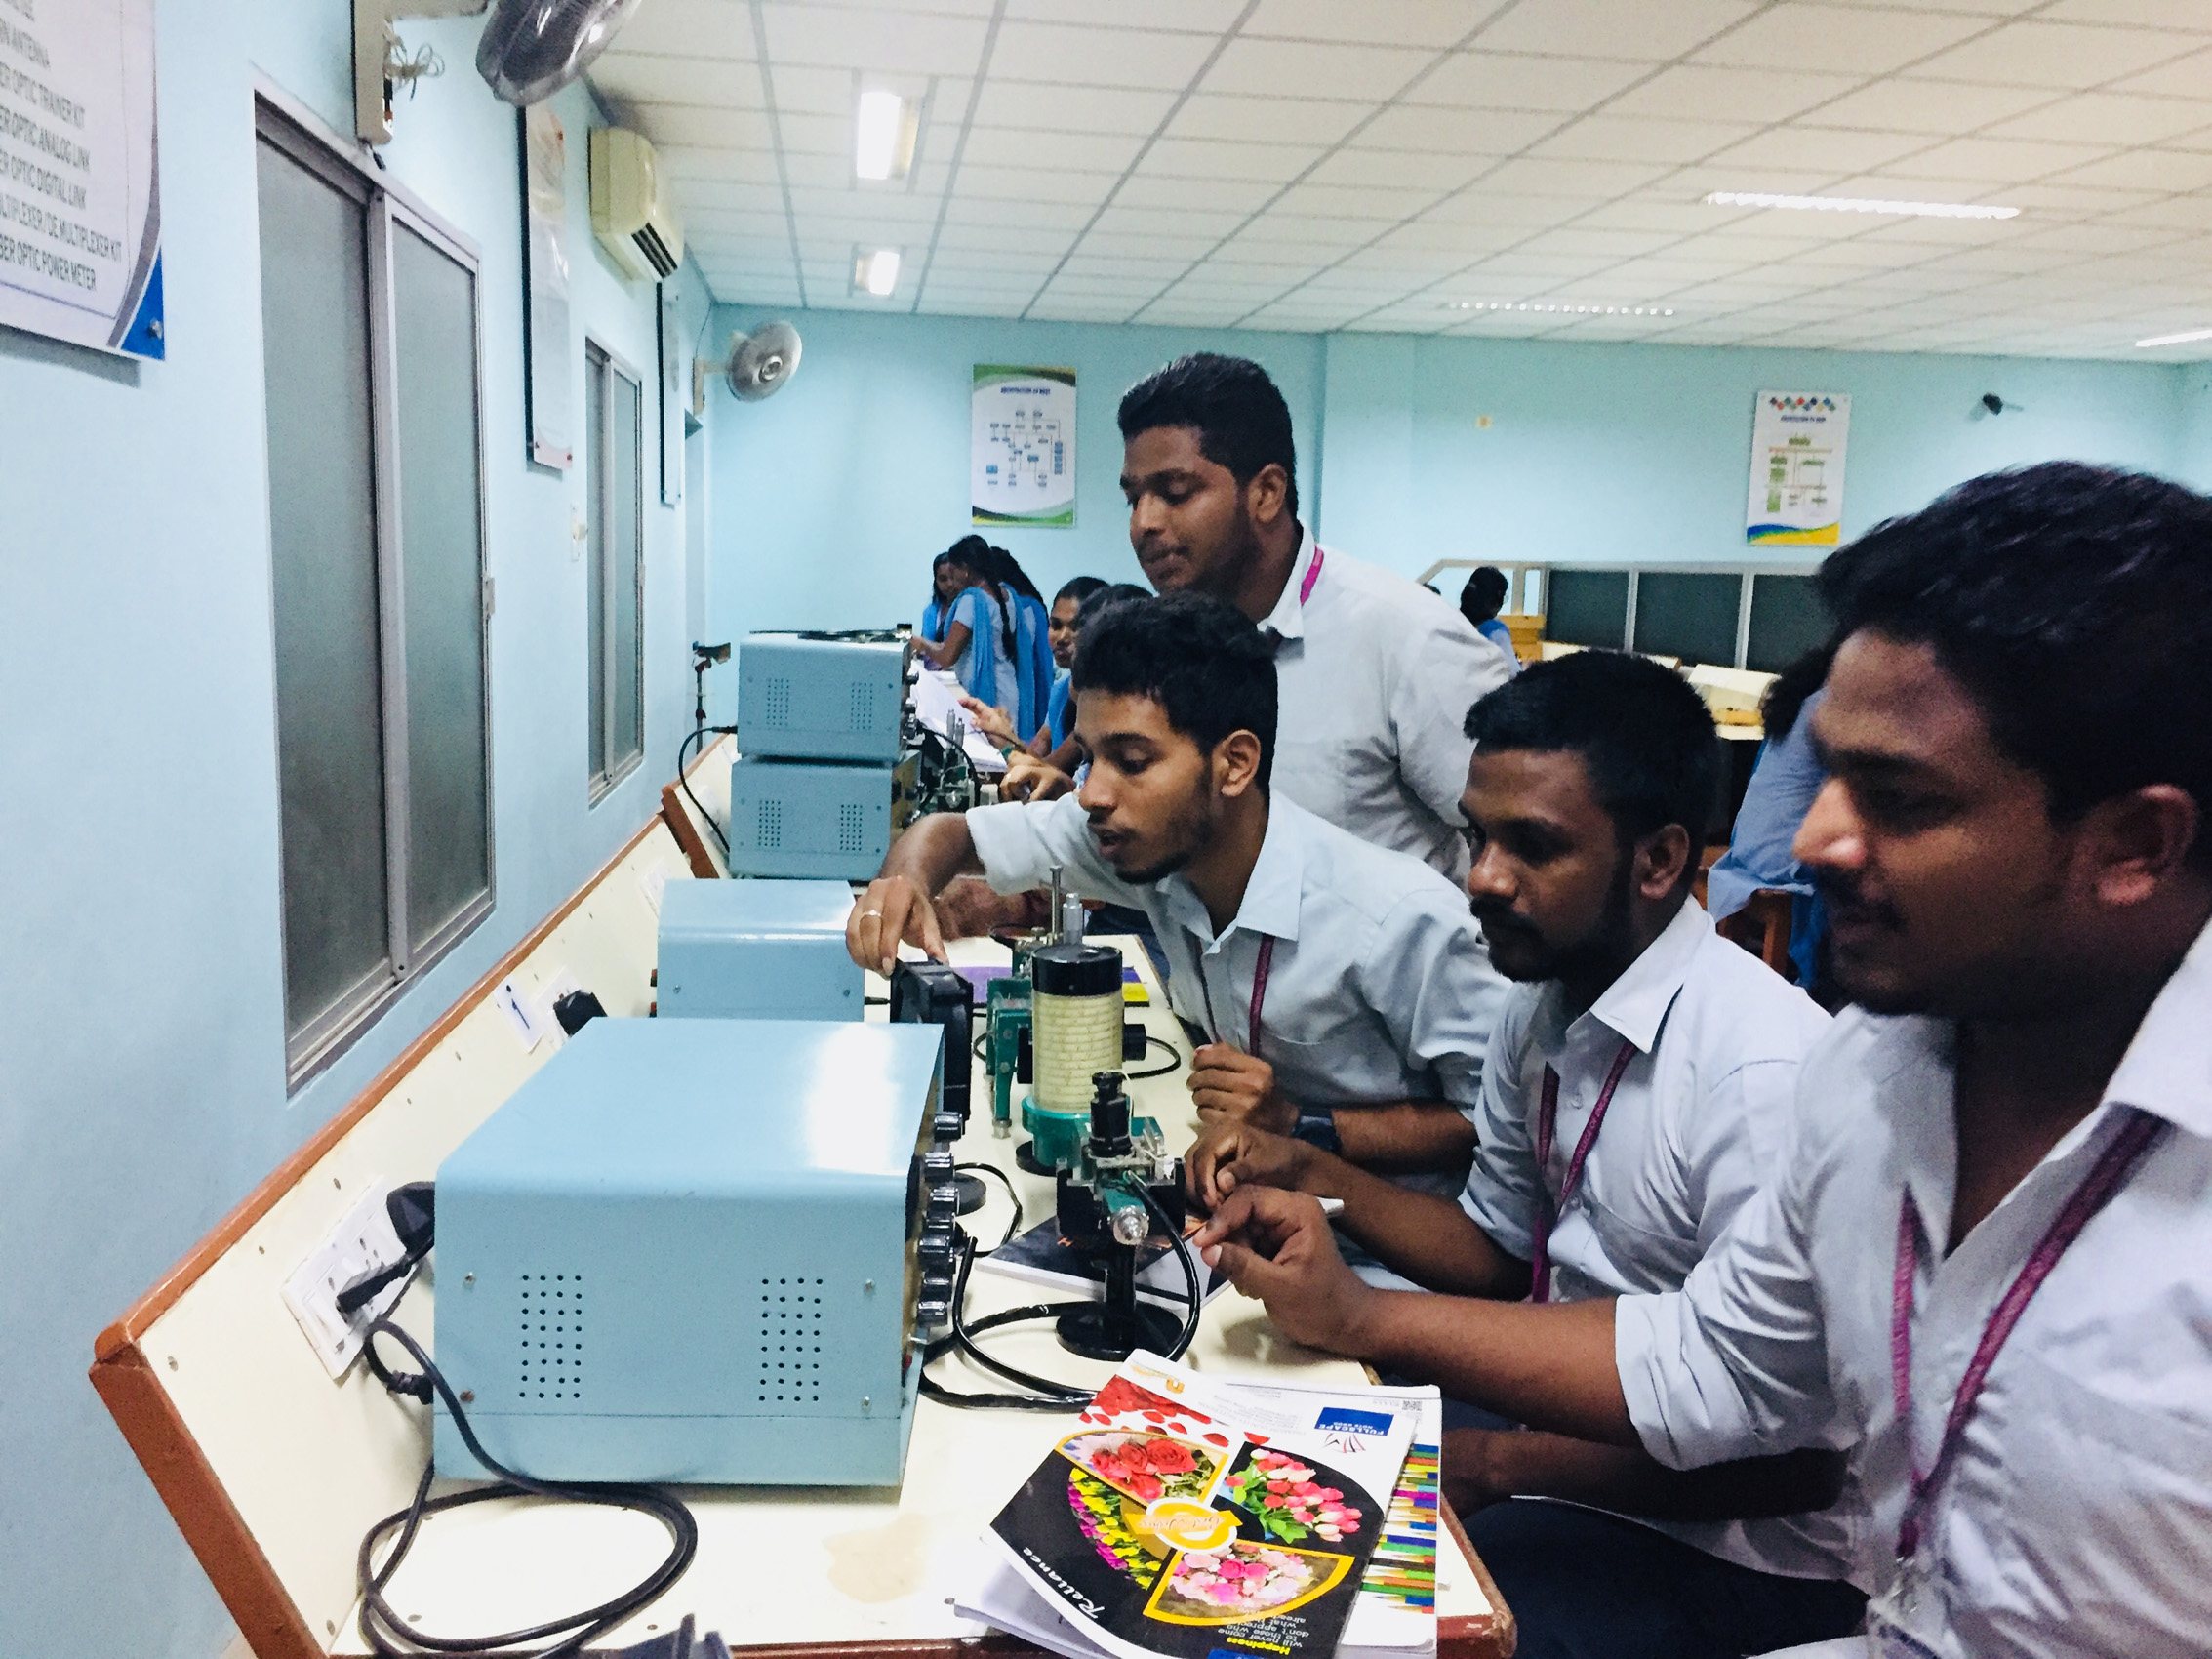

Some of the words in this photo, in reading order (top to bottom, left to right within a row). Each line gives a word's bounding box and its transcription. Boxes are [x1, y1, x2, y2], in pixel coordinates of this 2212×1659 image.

[12, 111, 37, 148] OPTIC
[38, 125, 71, 165] ANALOG
[11, 154, 35, 189] OPTIC
[17, 240, 41, 274] OPTIC
[42, 249, 70, 285] POWER
[71, 262, 97, 292] METER
[1023, 1546, 1105, 1619] Reliance
[1227, 1624, 1249, 1633] who
[1269, 1619, 1296, 1628] what
[1218, 1628, 1245, 1637] come
[1253, 1629, 1281, 1639] those
[1281, 1628, 1309, 1638] don't
[1249, 1634, 1279, 1643] never
[1282, 1639, 1303, 1648] will
[1227, 1637, 1291, 1656] Happiness
